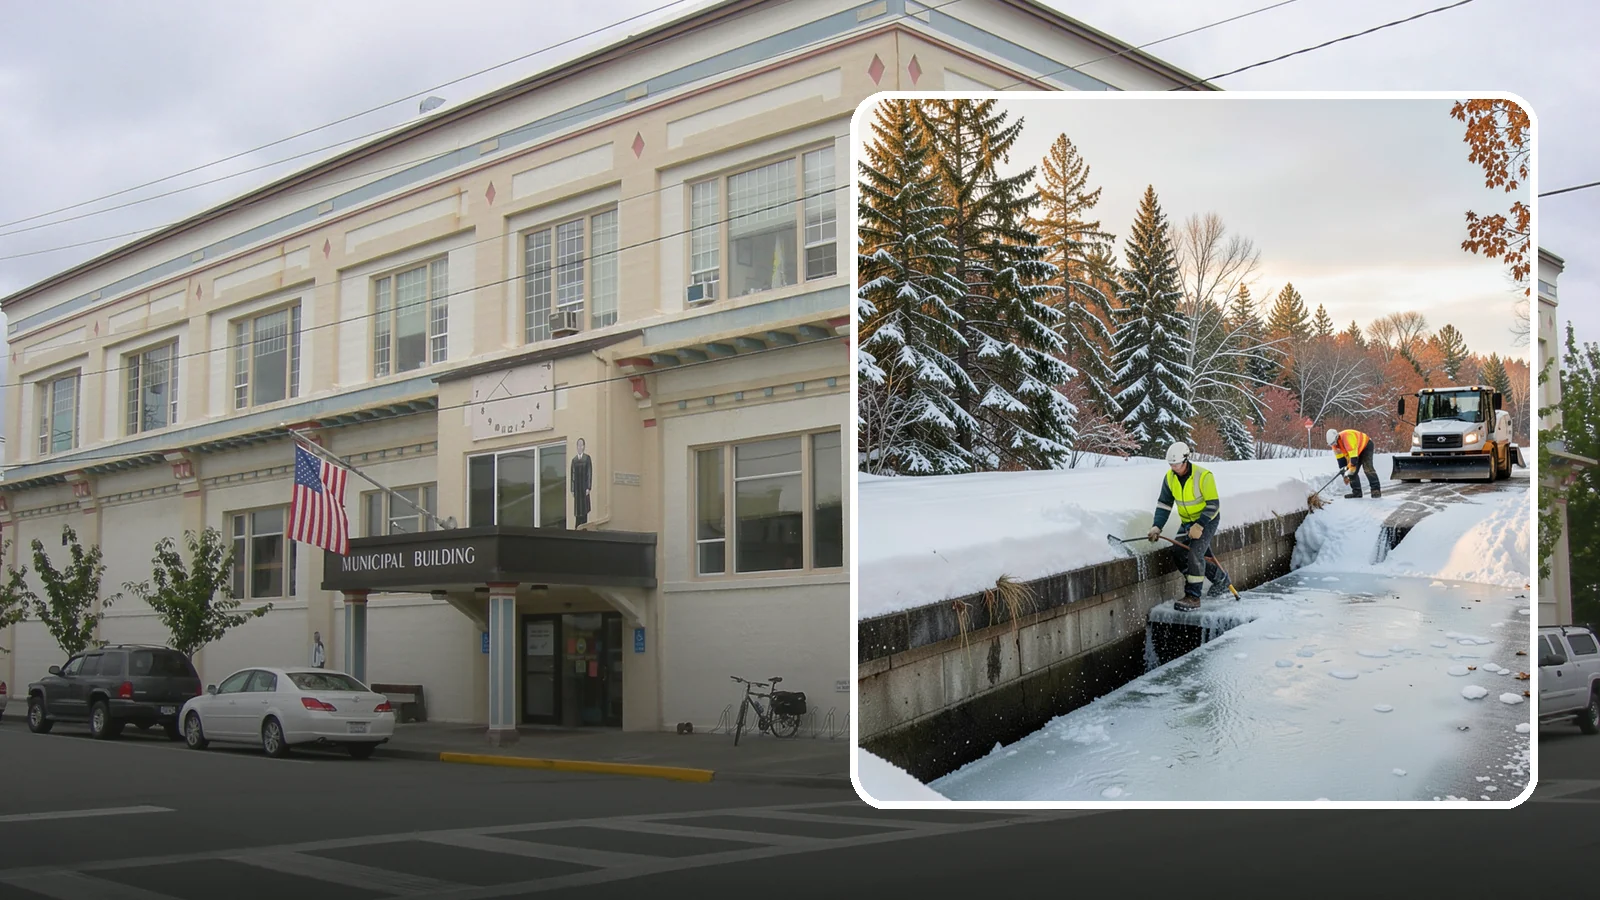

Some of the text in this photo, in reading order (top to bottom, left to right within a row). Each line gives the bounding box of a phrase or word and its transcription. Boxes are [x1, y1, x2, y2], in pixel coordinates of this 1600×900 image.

[480, 406, 485, 415] 8
[488, 418, 492, 426] 9
[494, 424, 500, 432] 10
[501, 426, 506, 434] 11
[508, 425, 514, 434] 12
[520, 420, 526, 428] 2
[528, 414, 533, 422] 3
[536, 402, 540, 410] 4
[342, 546, 475, 572] MUNICIPAL BUILDING
